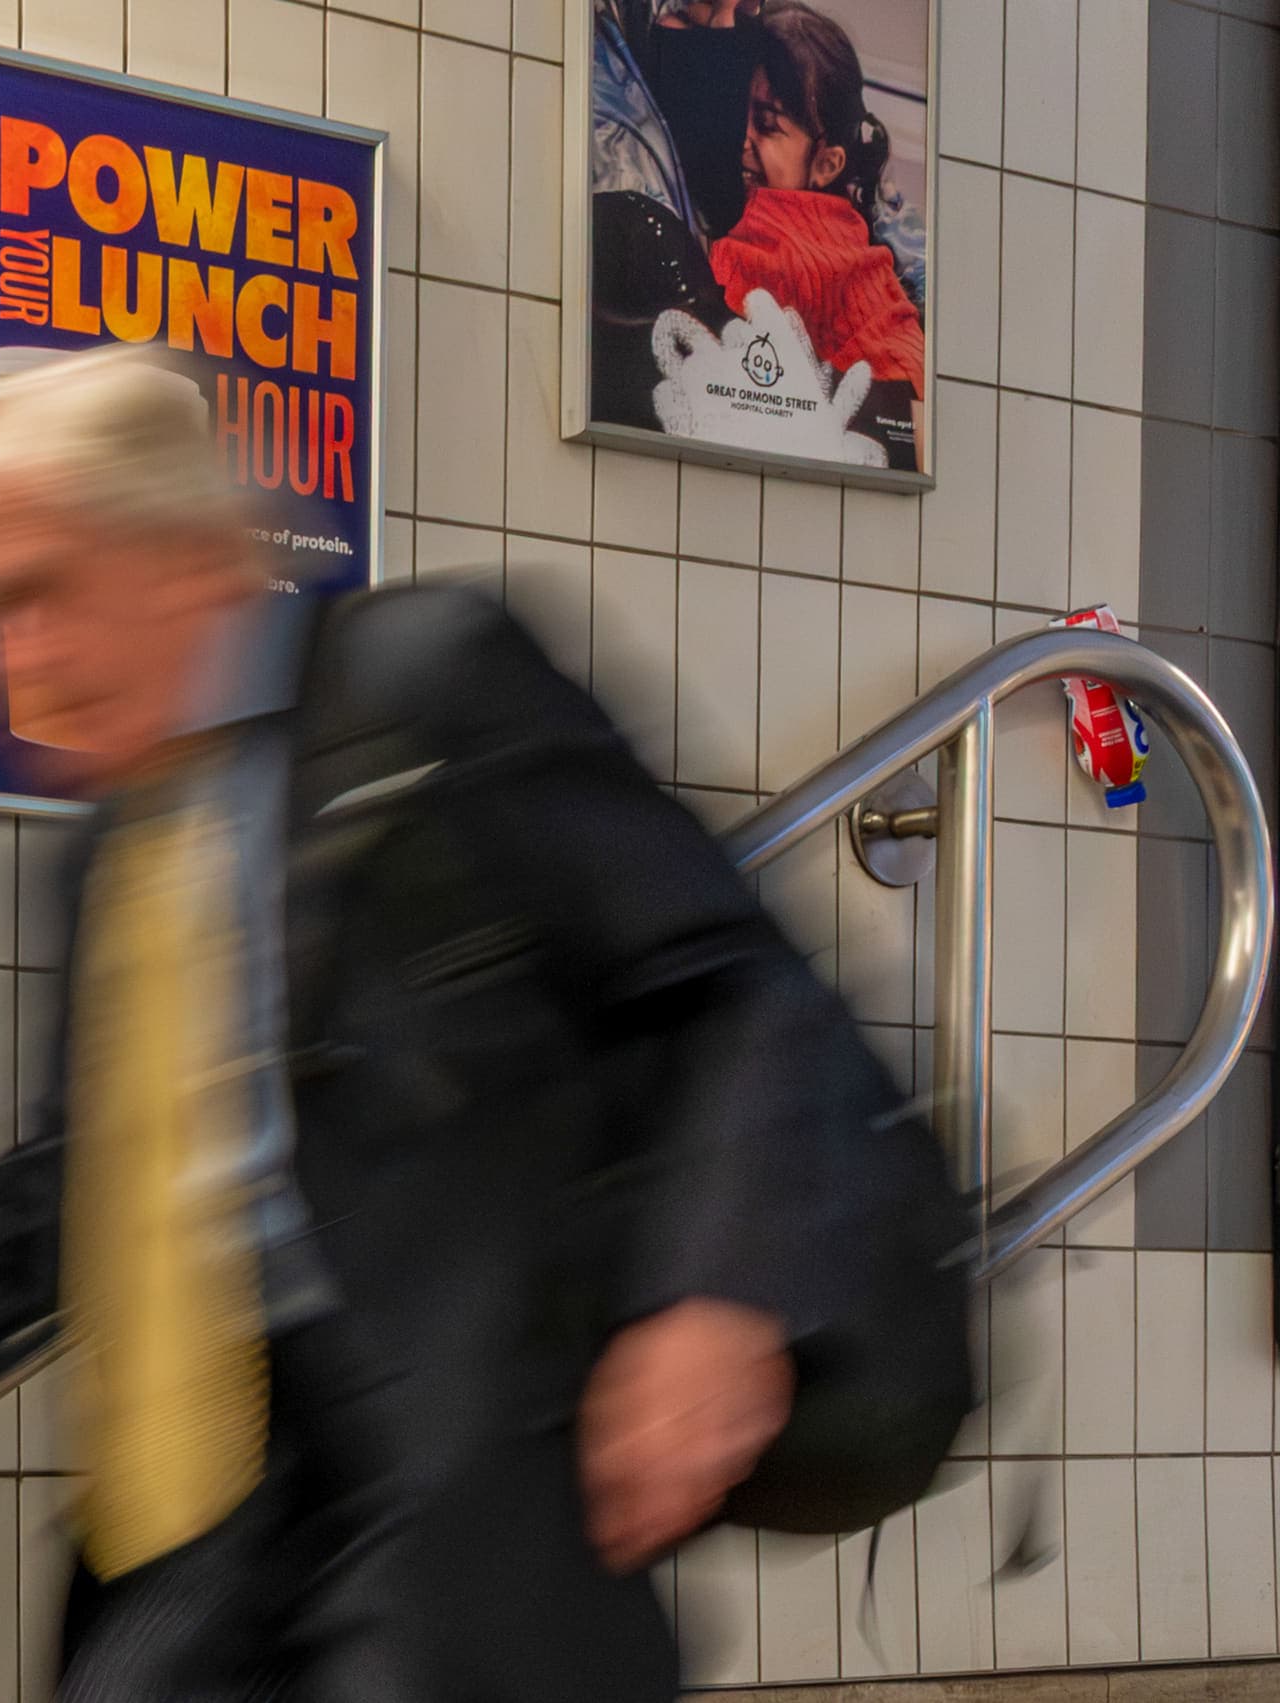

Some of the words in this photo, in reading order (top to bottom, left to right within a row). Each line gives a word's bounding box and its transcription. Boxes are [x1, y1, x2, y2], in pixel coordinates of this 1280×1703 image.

[0, 115, 359, 280] POWER
[51, 235, 357, 381] LUNCH
[706, 383, 736, 398] GREAT
[738, 389, 783, 406] ORMOND
[785, 397, 818, 412] STREET
[730, 402, 763, 414] HOSPITAL
[764, 407, 794, 419] CHARITY
[217, 373, 354, 502] HOUR
[273, 529, 291, 545] of
[292, 534, 353, 555] protein.
